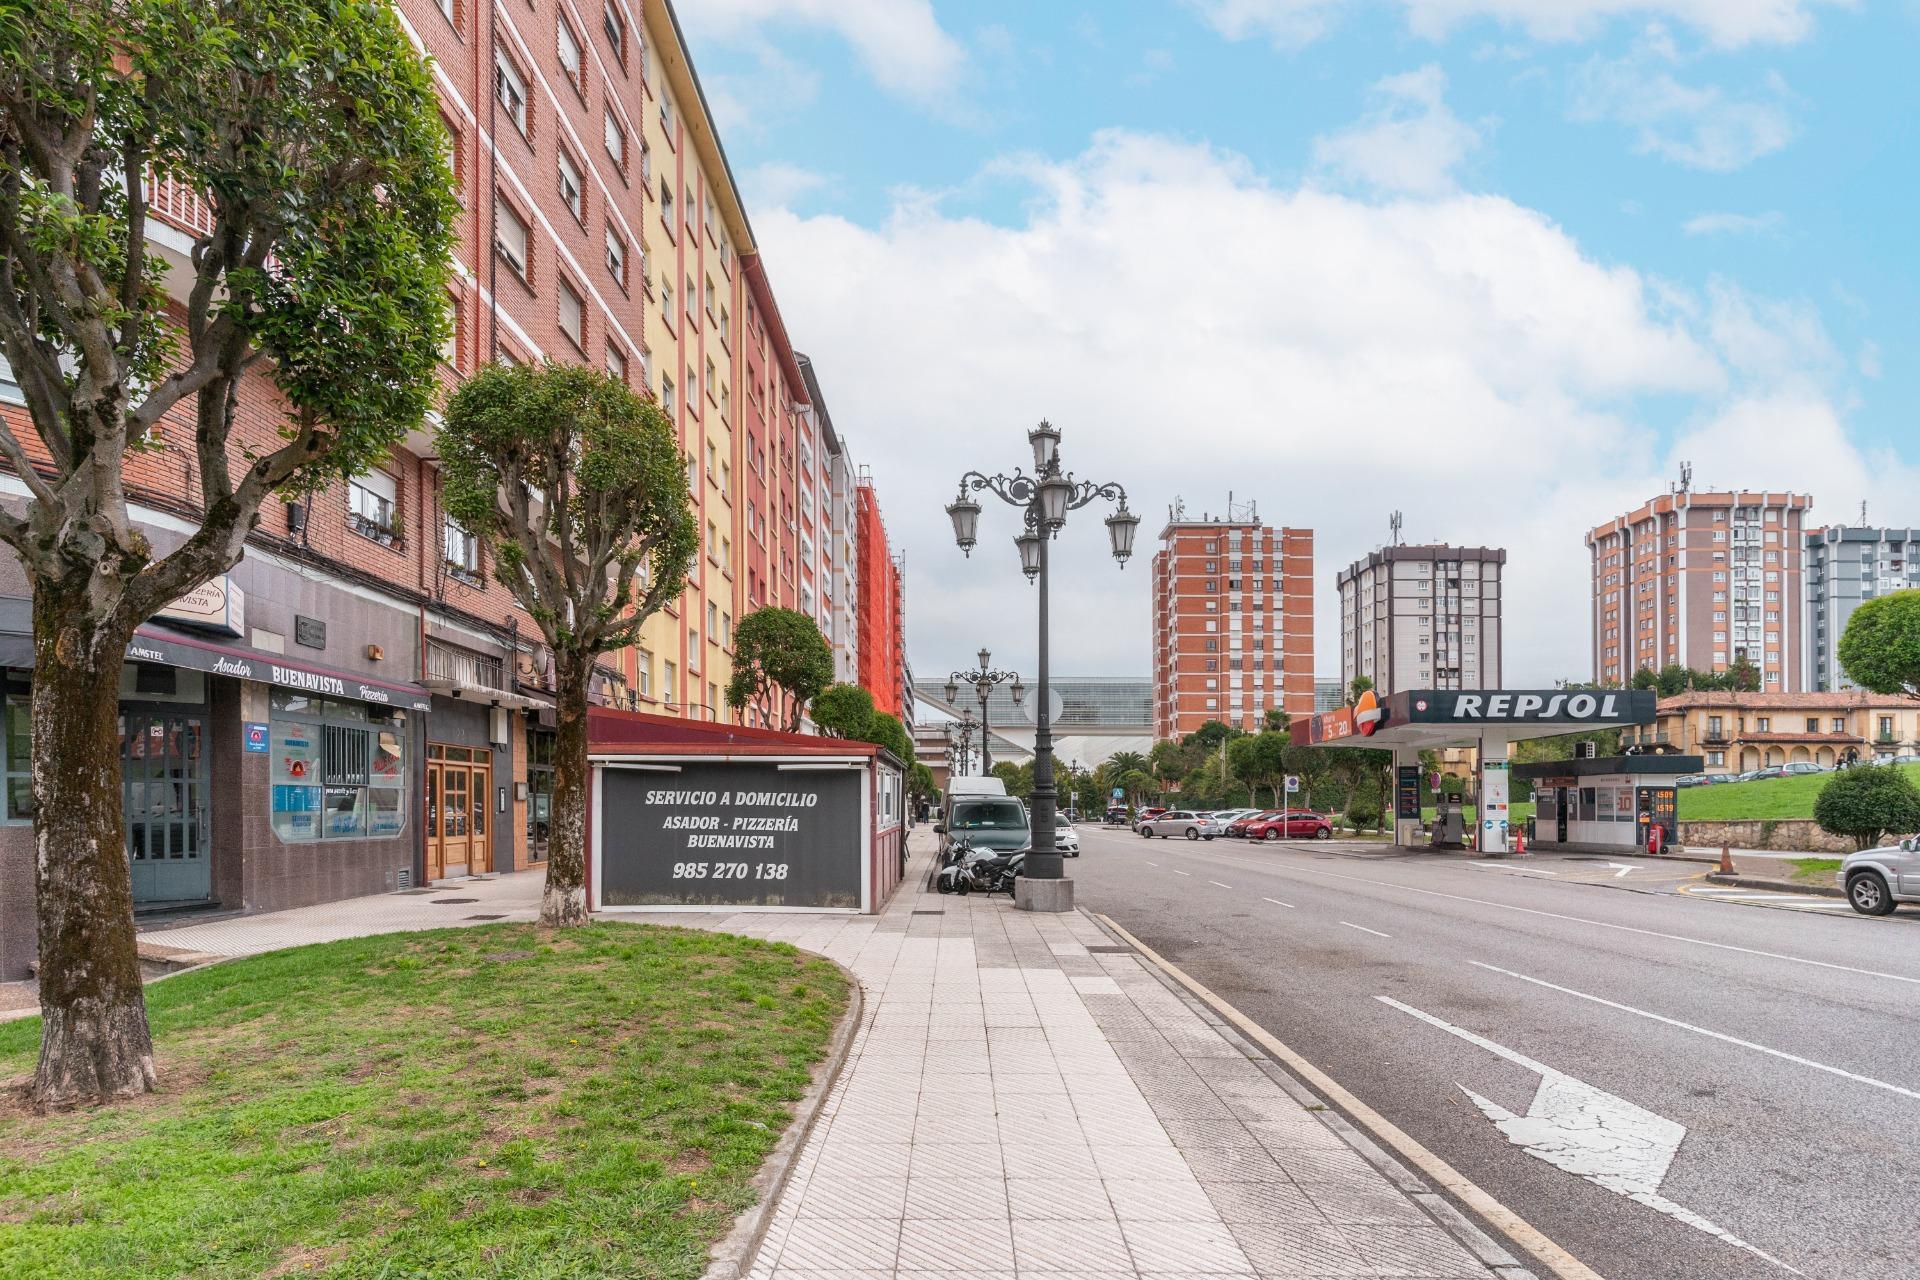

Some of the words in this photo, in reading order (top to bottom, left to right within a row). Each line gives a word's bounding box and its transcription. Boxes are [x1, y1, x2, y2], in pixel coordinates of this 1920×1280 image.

[191, 588, 220, 598] ZERÍA
[130, 647, 164, 661] AMSTEL
[213, 657, 252, 677] Asador
[272, 666, 344, 694] BUENAVISTA
[1453, 694, 1619, 718] REPSOL
[1338, 720, 1348, 736] 20
[645, 791, 717, 806] SERVICIO
[719, 792, 731, 806] A
[734, 792, 818, 807] DOMICILIO
[662, 816, 720, 830] ASADOR
[732, 815, 799, 832] PIZZERÍA
[686, 834, 775, 849] BUENAVISTA
[672, 862, 709, 879] 985
[712, 862, 749, 879] 270
[755, 863, 789, 880] 138
